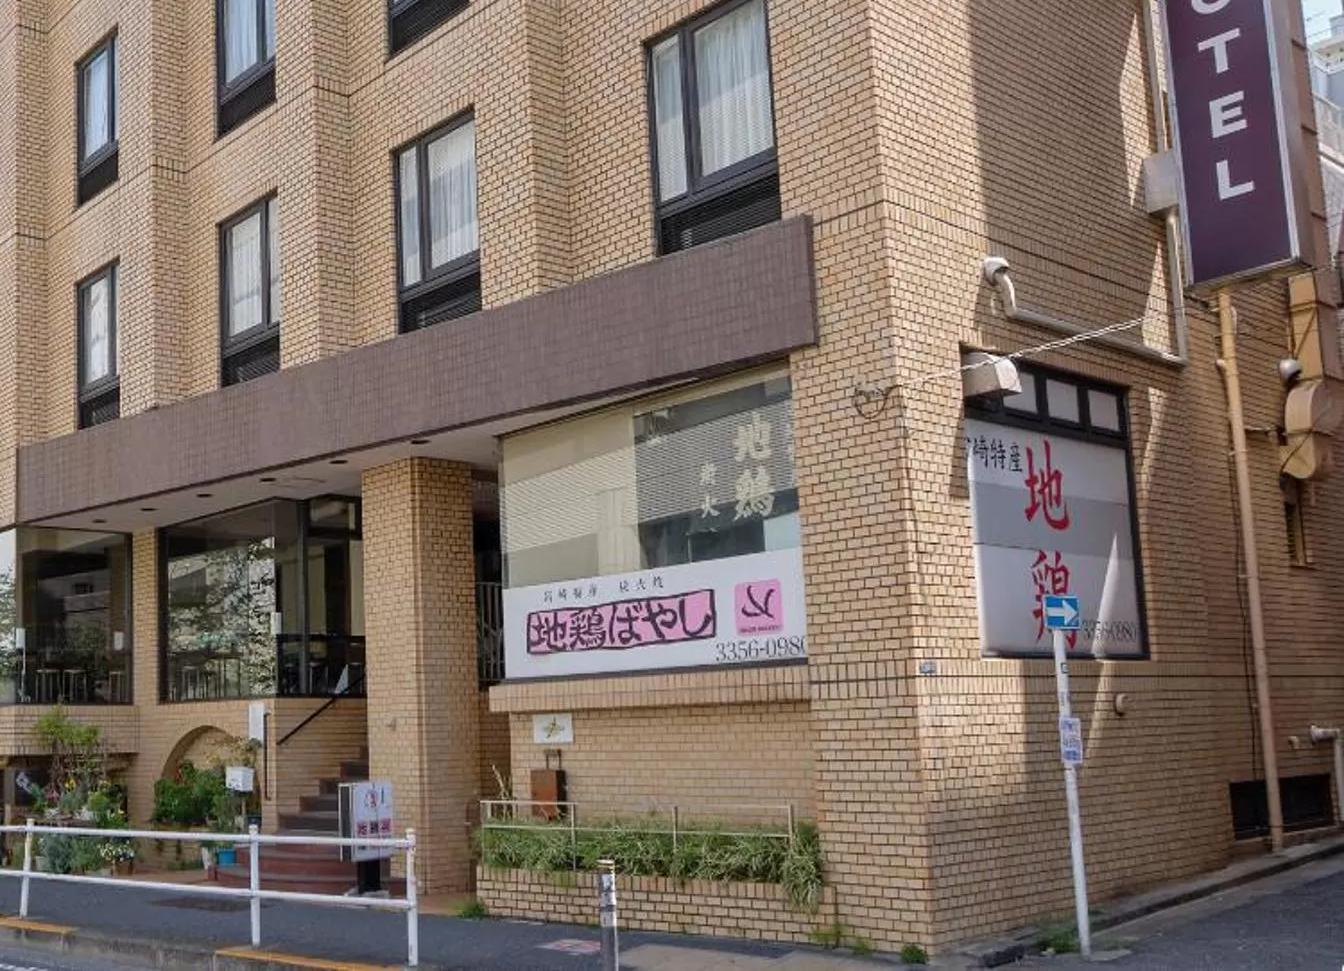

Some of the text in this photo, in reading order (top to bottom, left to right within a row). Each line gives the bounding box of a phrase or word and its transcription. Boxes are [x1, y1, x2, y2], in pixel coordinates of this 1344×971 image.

[965, 435, 1023, 473] 崎特産
[530, 597, 713, 651] 地鶏ばやし
